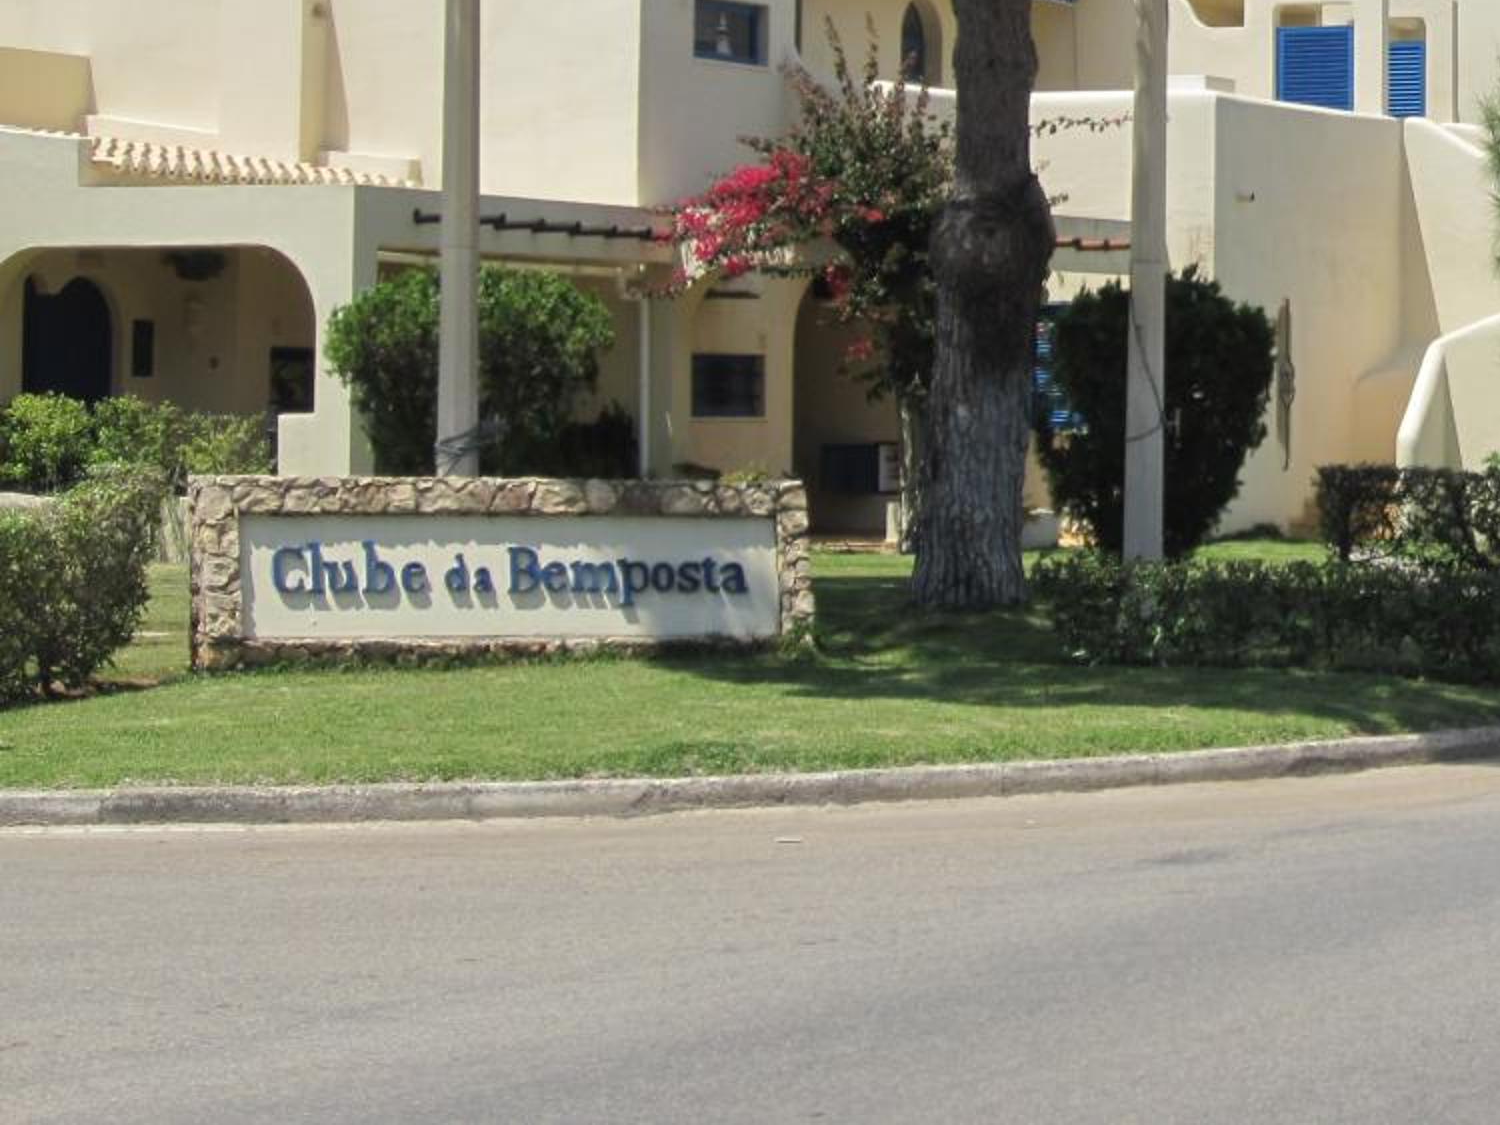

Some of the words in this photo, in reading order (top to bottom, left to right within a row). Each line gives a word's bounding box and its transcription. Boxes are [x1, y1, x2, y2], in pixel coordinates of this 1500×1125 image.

[271, 540, 427, 597] Clube
[445, 553, 494, 593] da
[507, 546, 749, 605] Bemposta
